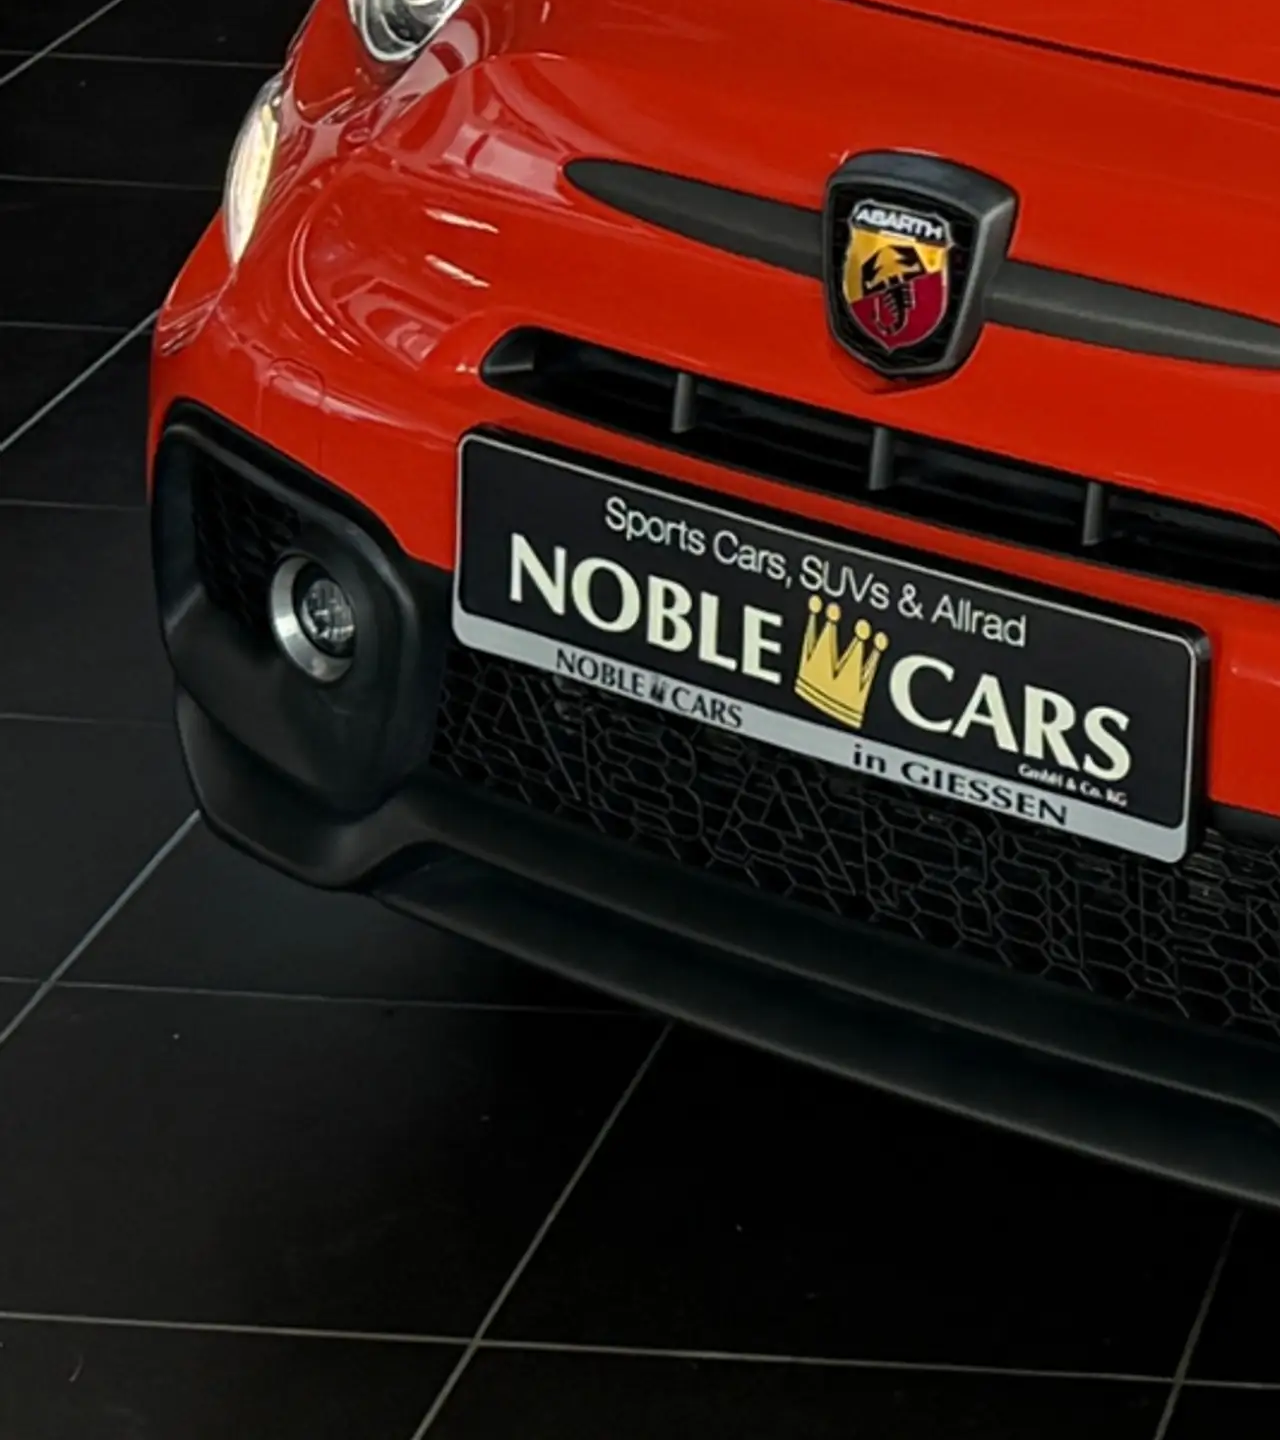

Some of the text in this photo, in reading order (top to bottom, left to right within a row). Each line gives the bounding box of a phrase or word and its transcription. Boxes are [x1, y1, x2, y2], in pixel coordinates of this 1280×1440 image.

[855, 207, 943, 240] ABARTH
[605, 496, 1027, 647] Sports Cars, SUVs & Allrad
[510, 532, 1131, 781] NOBLE CARS
[556, 648, 743, 729] NOBLE CARS
[853, 744, 1067, 825] in GIESSEN
